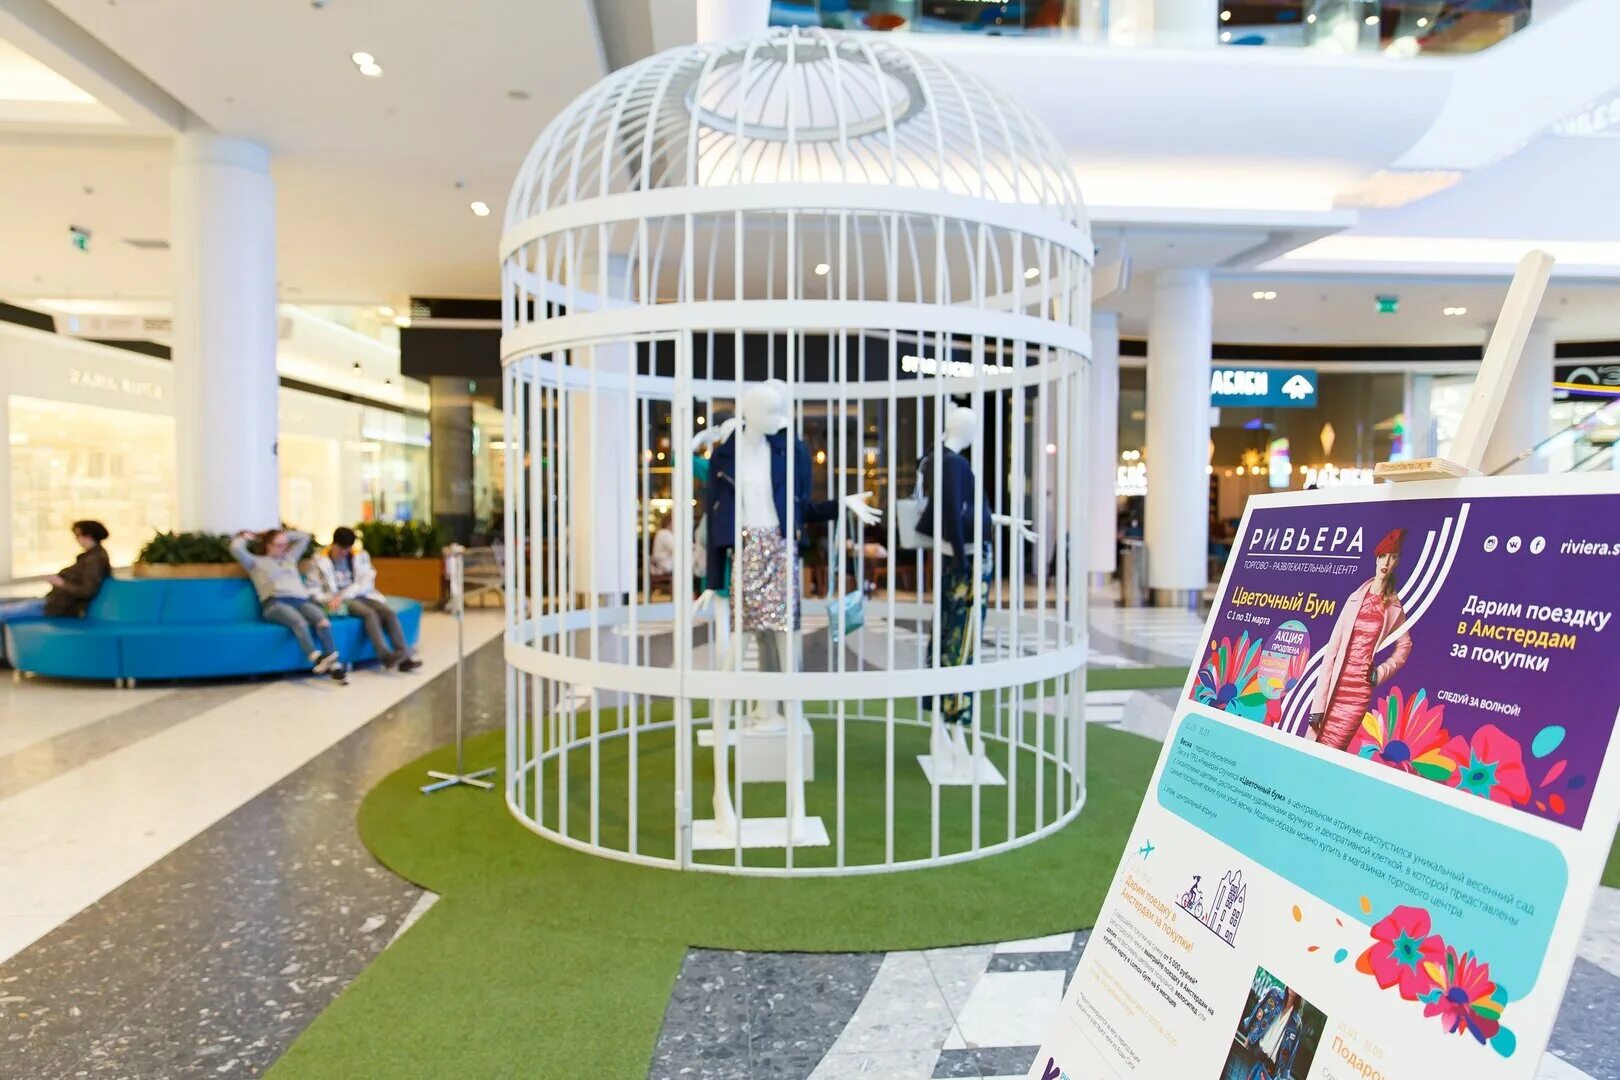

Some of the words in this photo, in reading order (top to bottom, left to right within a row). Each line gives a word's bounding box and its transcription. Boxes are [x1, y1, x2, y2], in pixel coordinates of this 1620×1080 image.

[1249, 526, 1362, 552] РИВЬЕРА
[1560, 539, 1620, 556] riviera.s
[1244, 560, 1268, 570] ТОРГОВО
[1272, 562, 1332, 574] РАЗВЛЕКАТЕЛЬНЫЙ
[1332, 565, 1358, 575] ЦЕНТР
[1232, 586, 1304, 612] Цветочный
[1304, 593, 1336, 619] Бум
[1462, 595, 1521, 618] Дарим
[1526, 604, 1612, 632] поездку
[1244, 612, 1252, 622] 31
[1252, 616, 1271, 626] марта
[1275, 631, 1304, 646] АКЦИЯ
[1457, 622, 1467, 634] в
[1470, 619, 1576, 650] Амстердам
[1271, 644, 1300, 654] ПРОДЛЕНА
[1450, 644, 1467, 658] за
[1471, 647, 1550, 672] покупки
[1438, 690, 1469, 705] СЛЕДУЙ
[1469, 696, 1479, 707] ЗА
[1480, 699, 1521, 717] ВОЛНОЙ!
[1180, 737, 1192, 748] Весна
[1253, 808, 1275, 825] Модные
[1275, 820, 1296, 834] образы
[1296, 831, 1318, 846] можно
[1319, 843, 1340, 858] купить
[1348, 856, 1385, 878] магазинах
[1388, 875, 1429, 900] торгового
[1430, 896, 1463, 918] центра.
[1292, 801, 1332, 823] центральном
[1332, 818, 1364, 838] атриуме
[1363, 832, 1412, 859] распустился
[1412, 854, 1464, 882] уникальный
[1466, 878, 1514, 904] весенний
[1516, 900, 1534, 916] сад
[1320, 827, 1370, 856] декоративной
[1412, 871, 1448, 893] которой
[1450, 888, 1518, 925] представлены
[1125, 875, 1146, 895] Дарим
[1145, 892, 1172, 919] поездку
[1171, 914, 1176, 922] в
[1121, 887, 1154, 919] Амстердам
[1154, 916, 1162, 927] за
[1162, 923, 1194, 952] покупки!
[1142, 971, 1151, 983] Gym
[1172, 959, 1181, 971] 000
[1184, 983, 1208, 1009] Амстердам
[1332, 1035, 1388, 1080] Подаро
